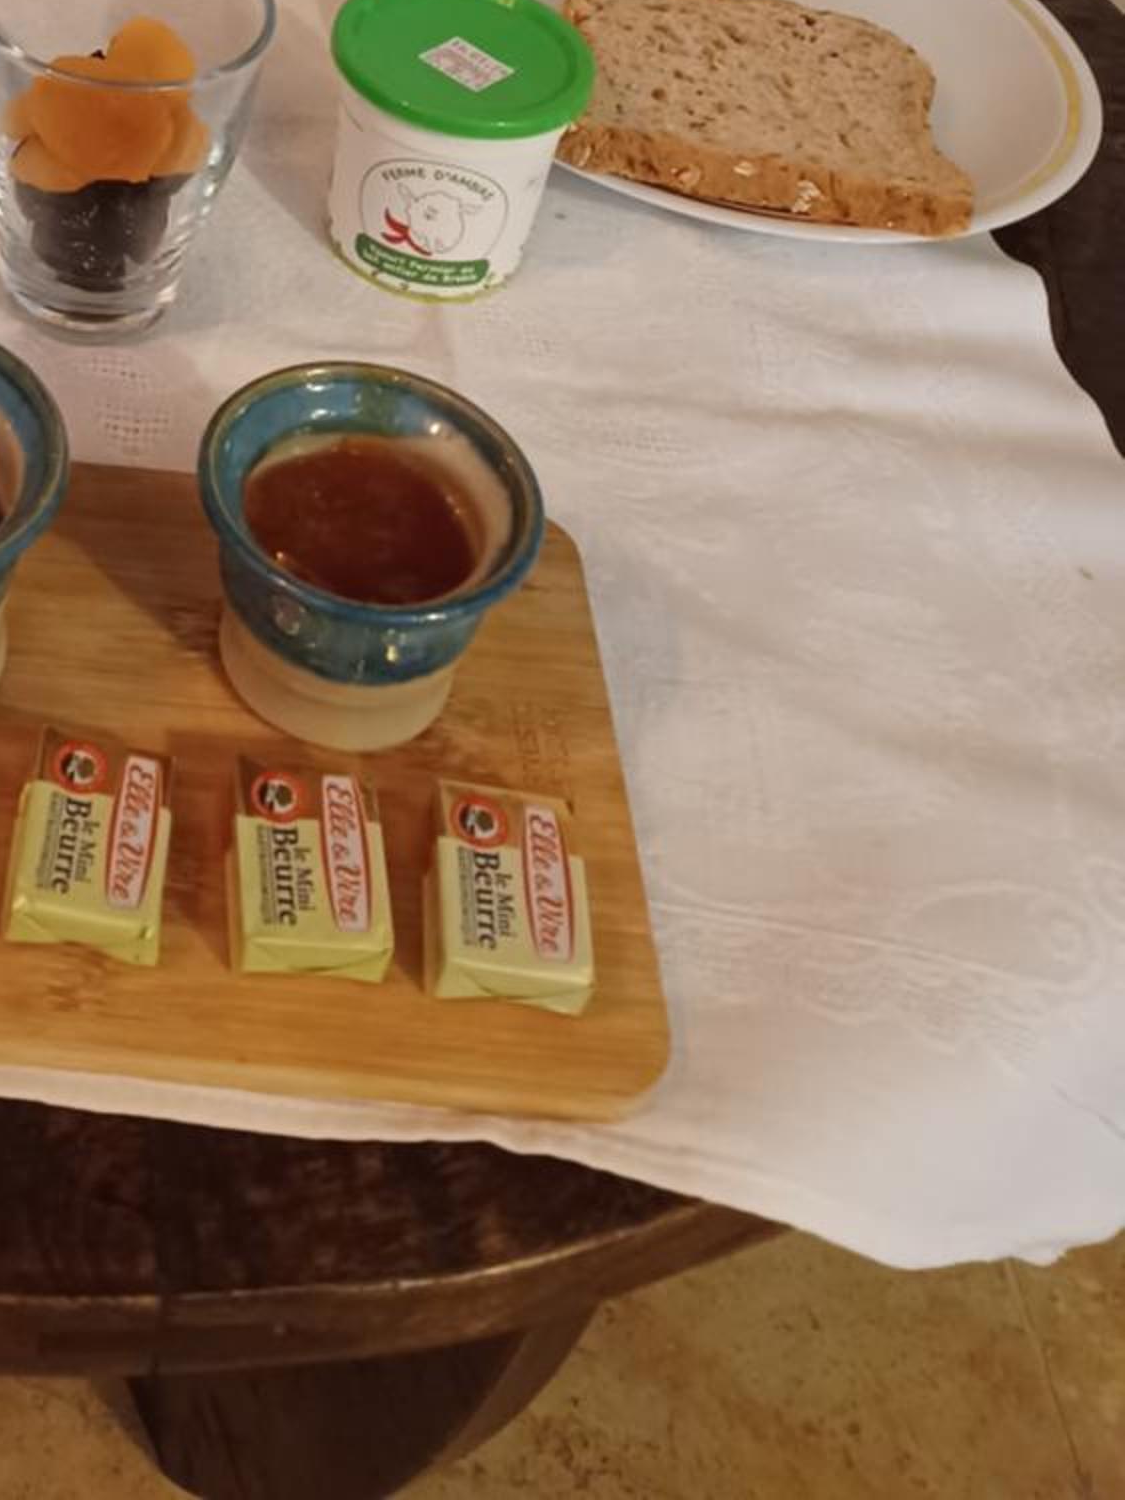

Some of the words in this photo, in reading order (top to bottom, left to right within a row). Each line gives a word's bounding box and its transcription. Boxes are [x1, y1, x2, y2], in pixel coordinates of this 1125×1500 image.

[381, 166, 426, 181] FERME
[126, 764, 154, 818] Elle
[326, 782, 355, 838] Elle
[52, 797, 92, 894] Beurre
[82, 819, 100, 835] le
[529, 814, 558, 868] Elle
[75, 839, 96, 884] Mini
[112, 842, 144, 900] Vire
[272, 827, 298, 926] Beurre
[293, 847, 311, 863] le
[494, 872, 513, 889] le
[297, 867, 317, 911] Mini
[335, 866, 362, 922] Vire
[474, 852, 500, 950] Beurre
[497, 894, 518, 938] Mini
[537, 896, 564, 951] Vire
